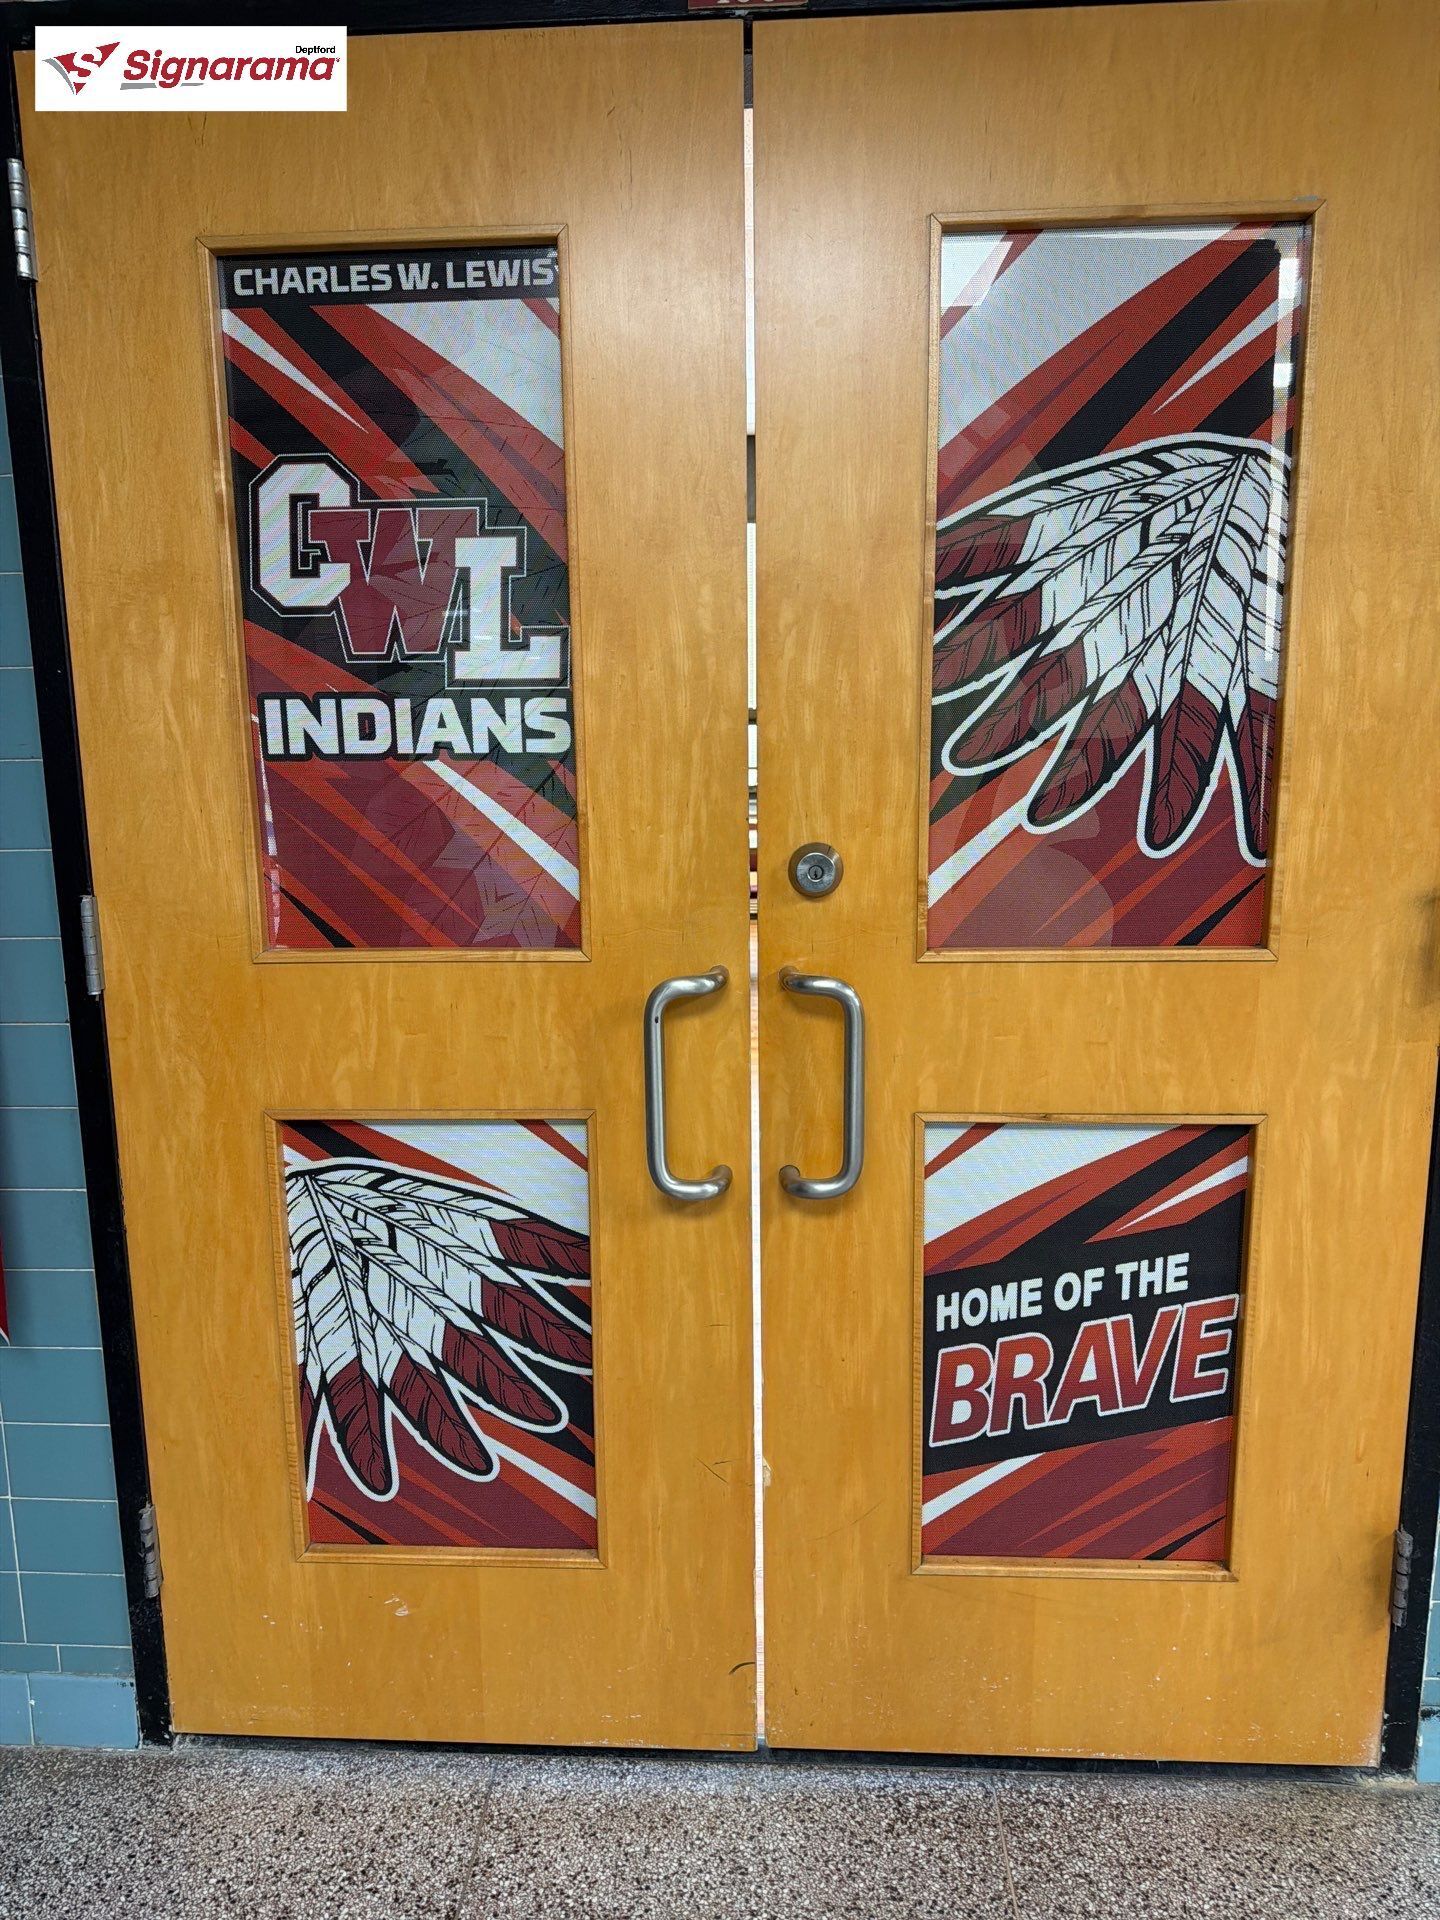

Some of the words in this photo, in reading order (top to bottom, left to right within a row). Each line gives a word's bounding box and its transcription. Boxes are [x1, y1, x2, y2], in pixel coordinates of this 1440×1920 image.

[233, 264, 393, 296] CHARLES
[396, 263, 439, 290] W.
[446, 257, 554, 289] LEWIS
[263, 697, 572, 755] INDIANS
[936, 1278, 1043, 1332] HOME
[1053, 1267, 1105, 1311] OF
[1115, 1253, 1190, 1300] THE
[928, 1293, 1240, 1448] BRAVE
